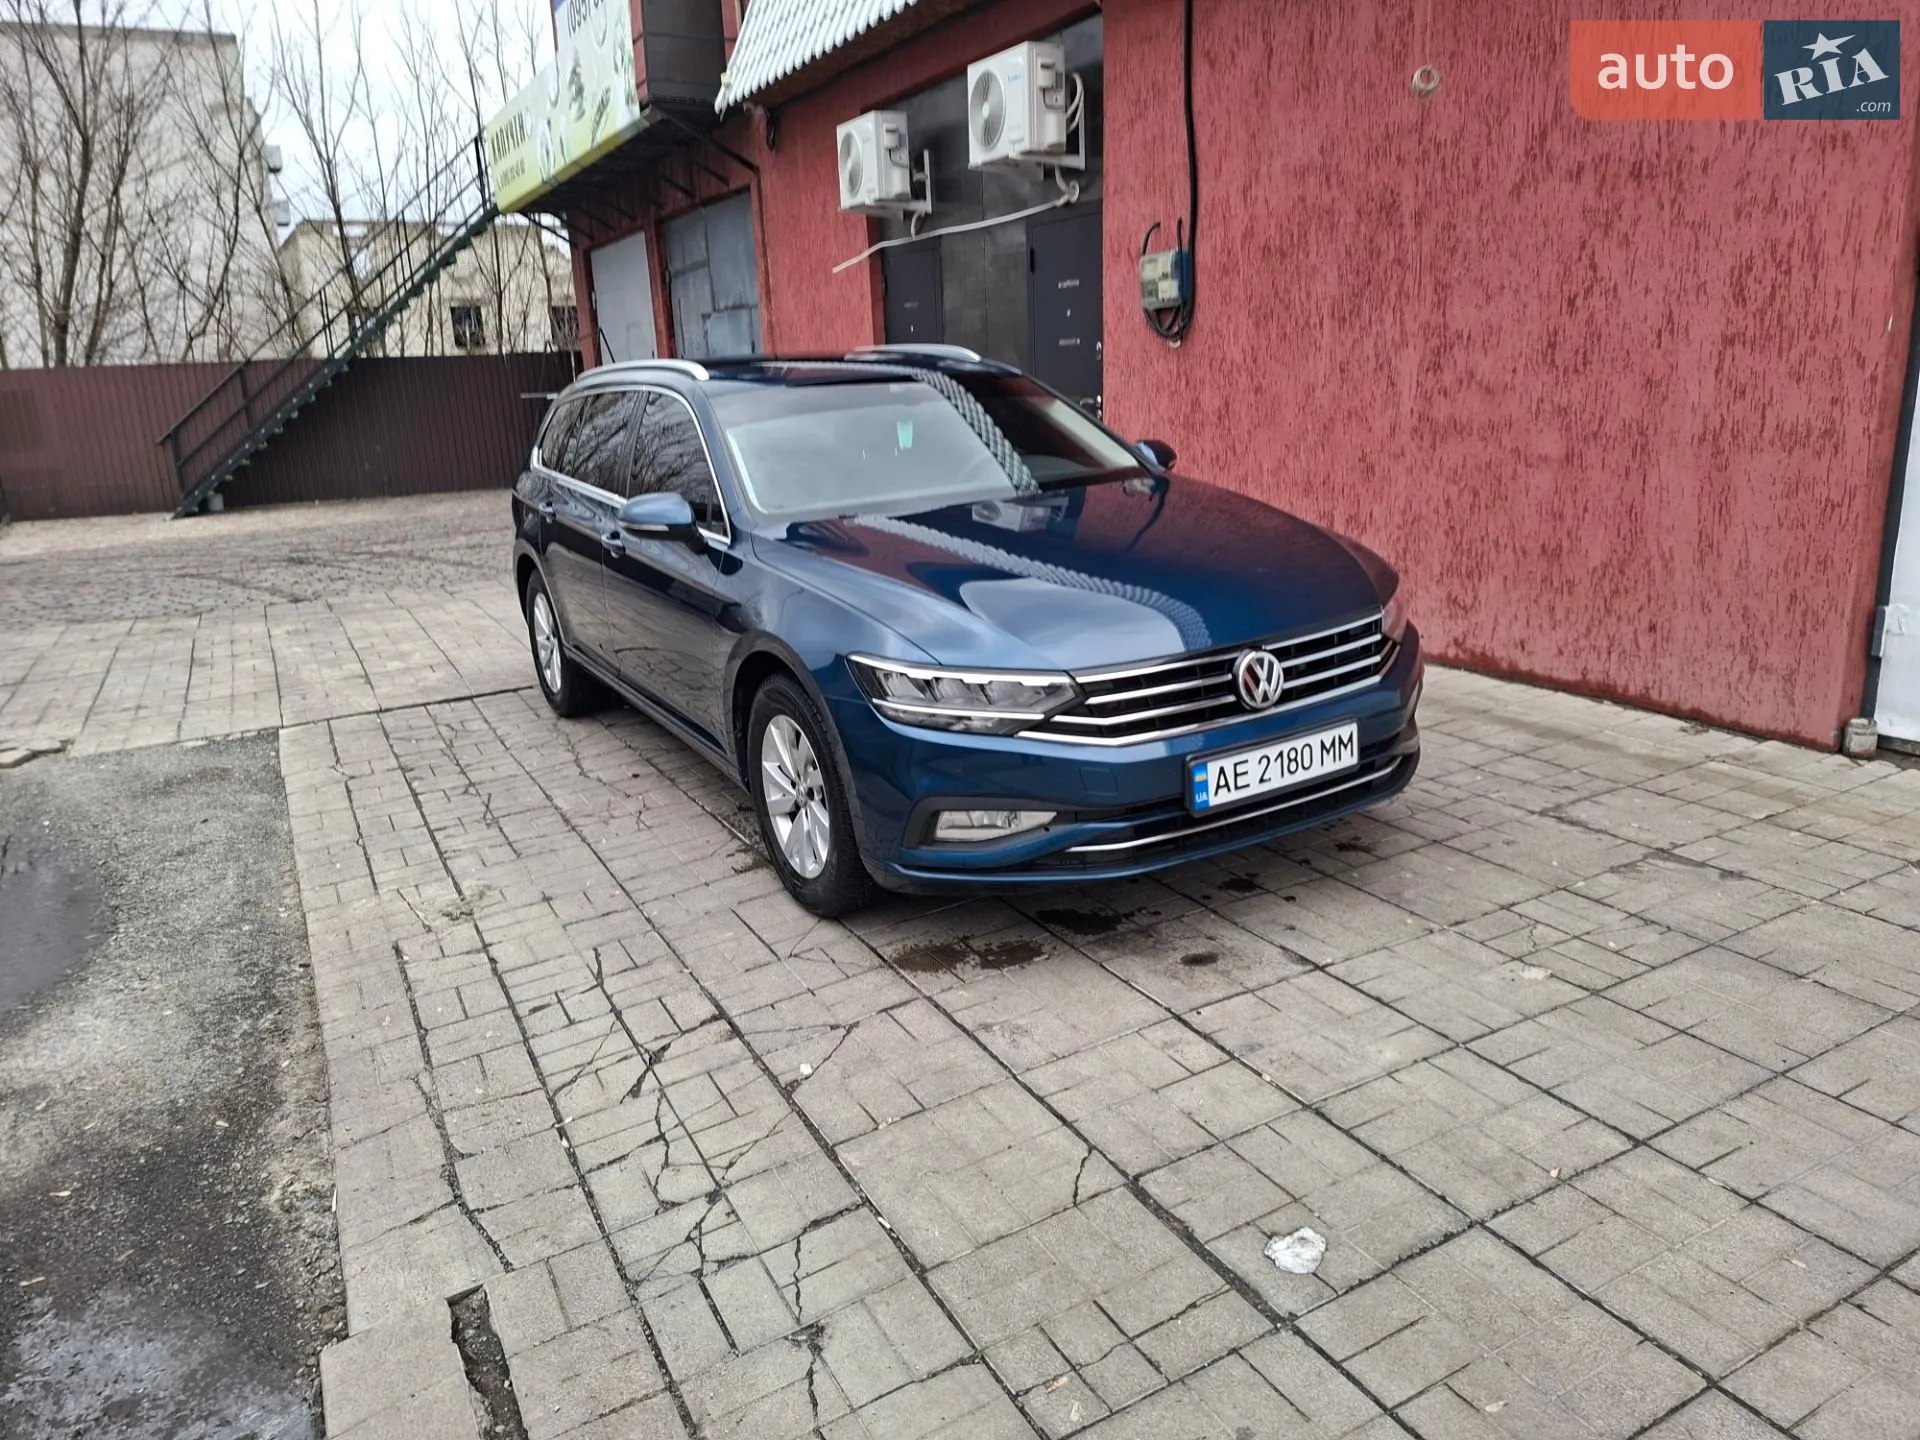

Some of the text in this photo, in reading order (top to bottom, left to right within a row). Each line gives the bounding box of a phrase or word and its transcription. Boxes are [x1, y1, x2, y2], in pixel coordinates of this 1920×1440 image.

[1214, 730, 1355, 796] AE 2180 MM
[1195, 791, 1208, 803] UA
